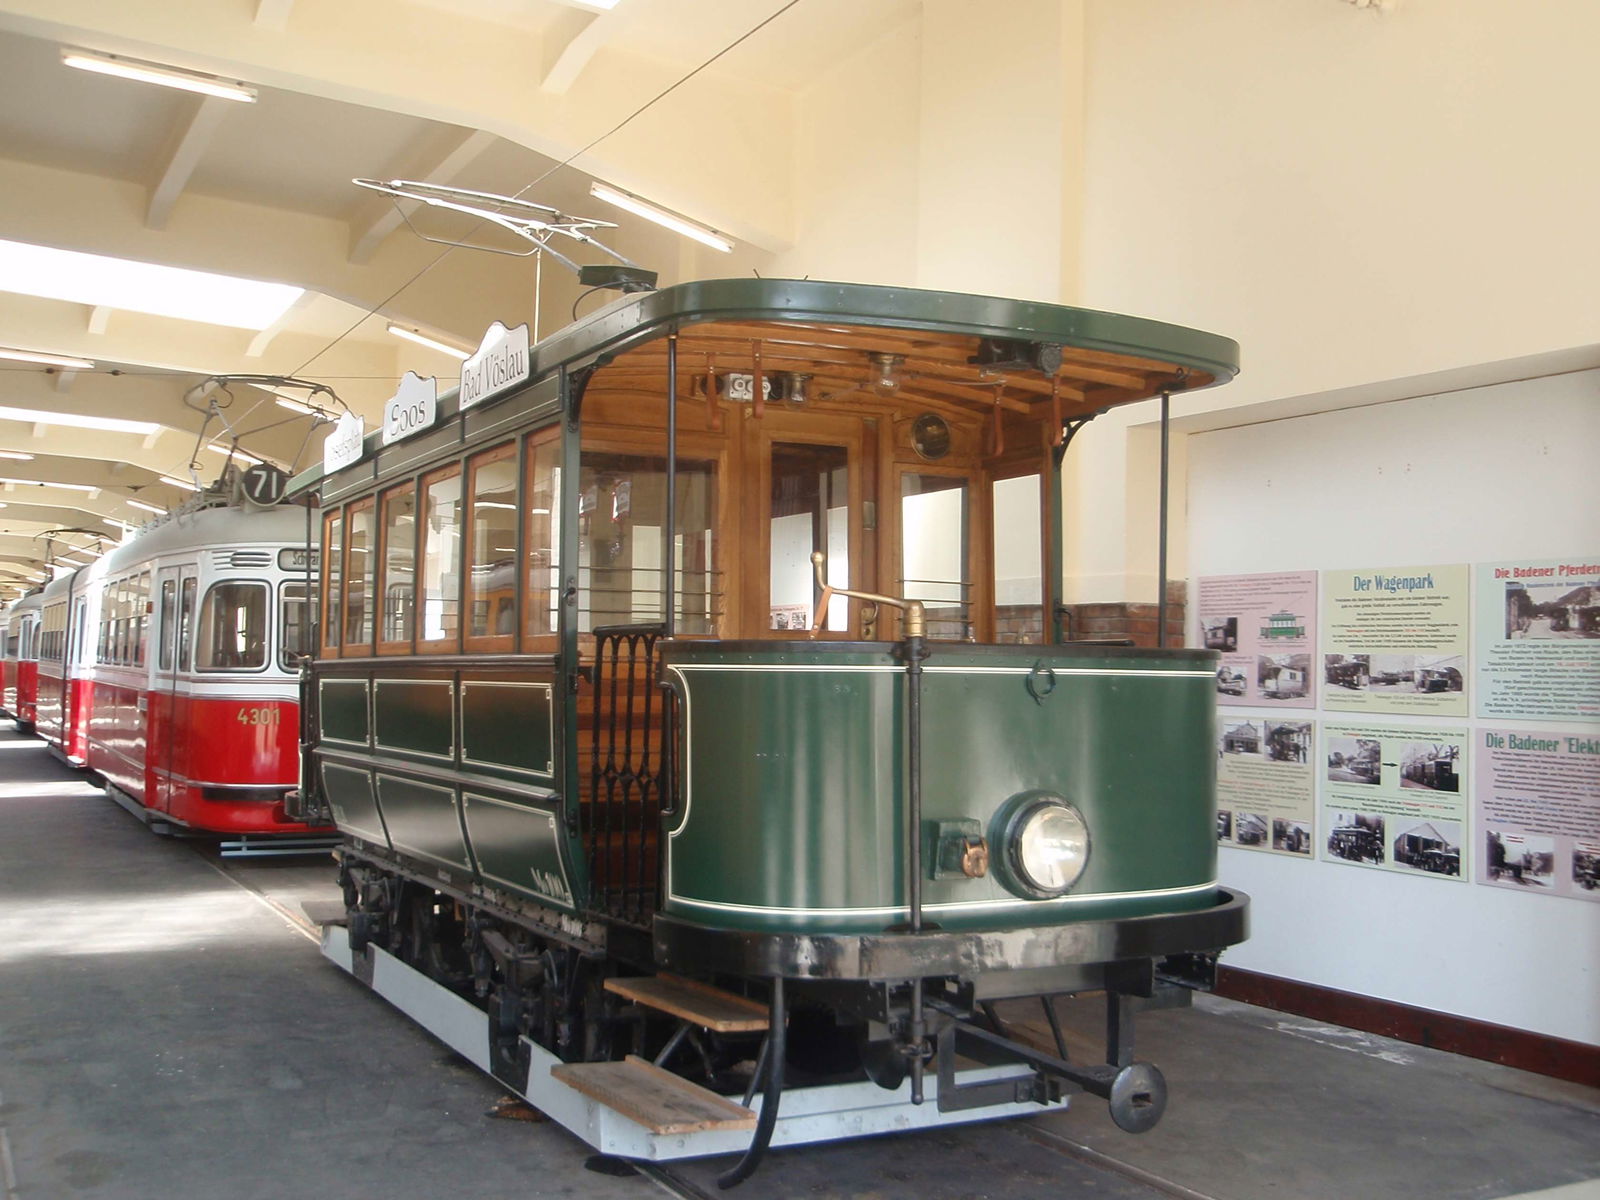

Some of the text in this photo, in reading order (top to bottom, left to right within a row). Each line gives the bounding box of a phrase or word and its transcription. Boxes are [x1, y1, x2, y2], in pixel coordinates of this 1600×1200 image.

[463, 344, 524, 403] Bad Vöslau
[391, 401, 425, 436] Soos
[251, 470, 278, 499] 71
[1494, 568, 1510, 579] Die
[1513, 566, 1555, 578] Badener
[1353, 573, 1434, 593] Der Wagenpark
[237, 708, 280, 725] 4301
[1486, 733, 1505, 748] Die
[1508, 734, 1559, 752] Badener
